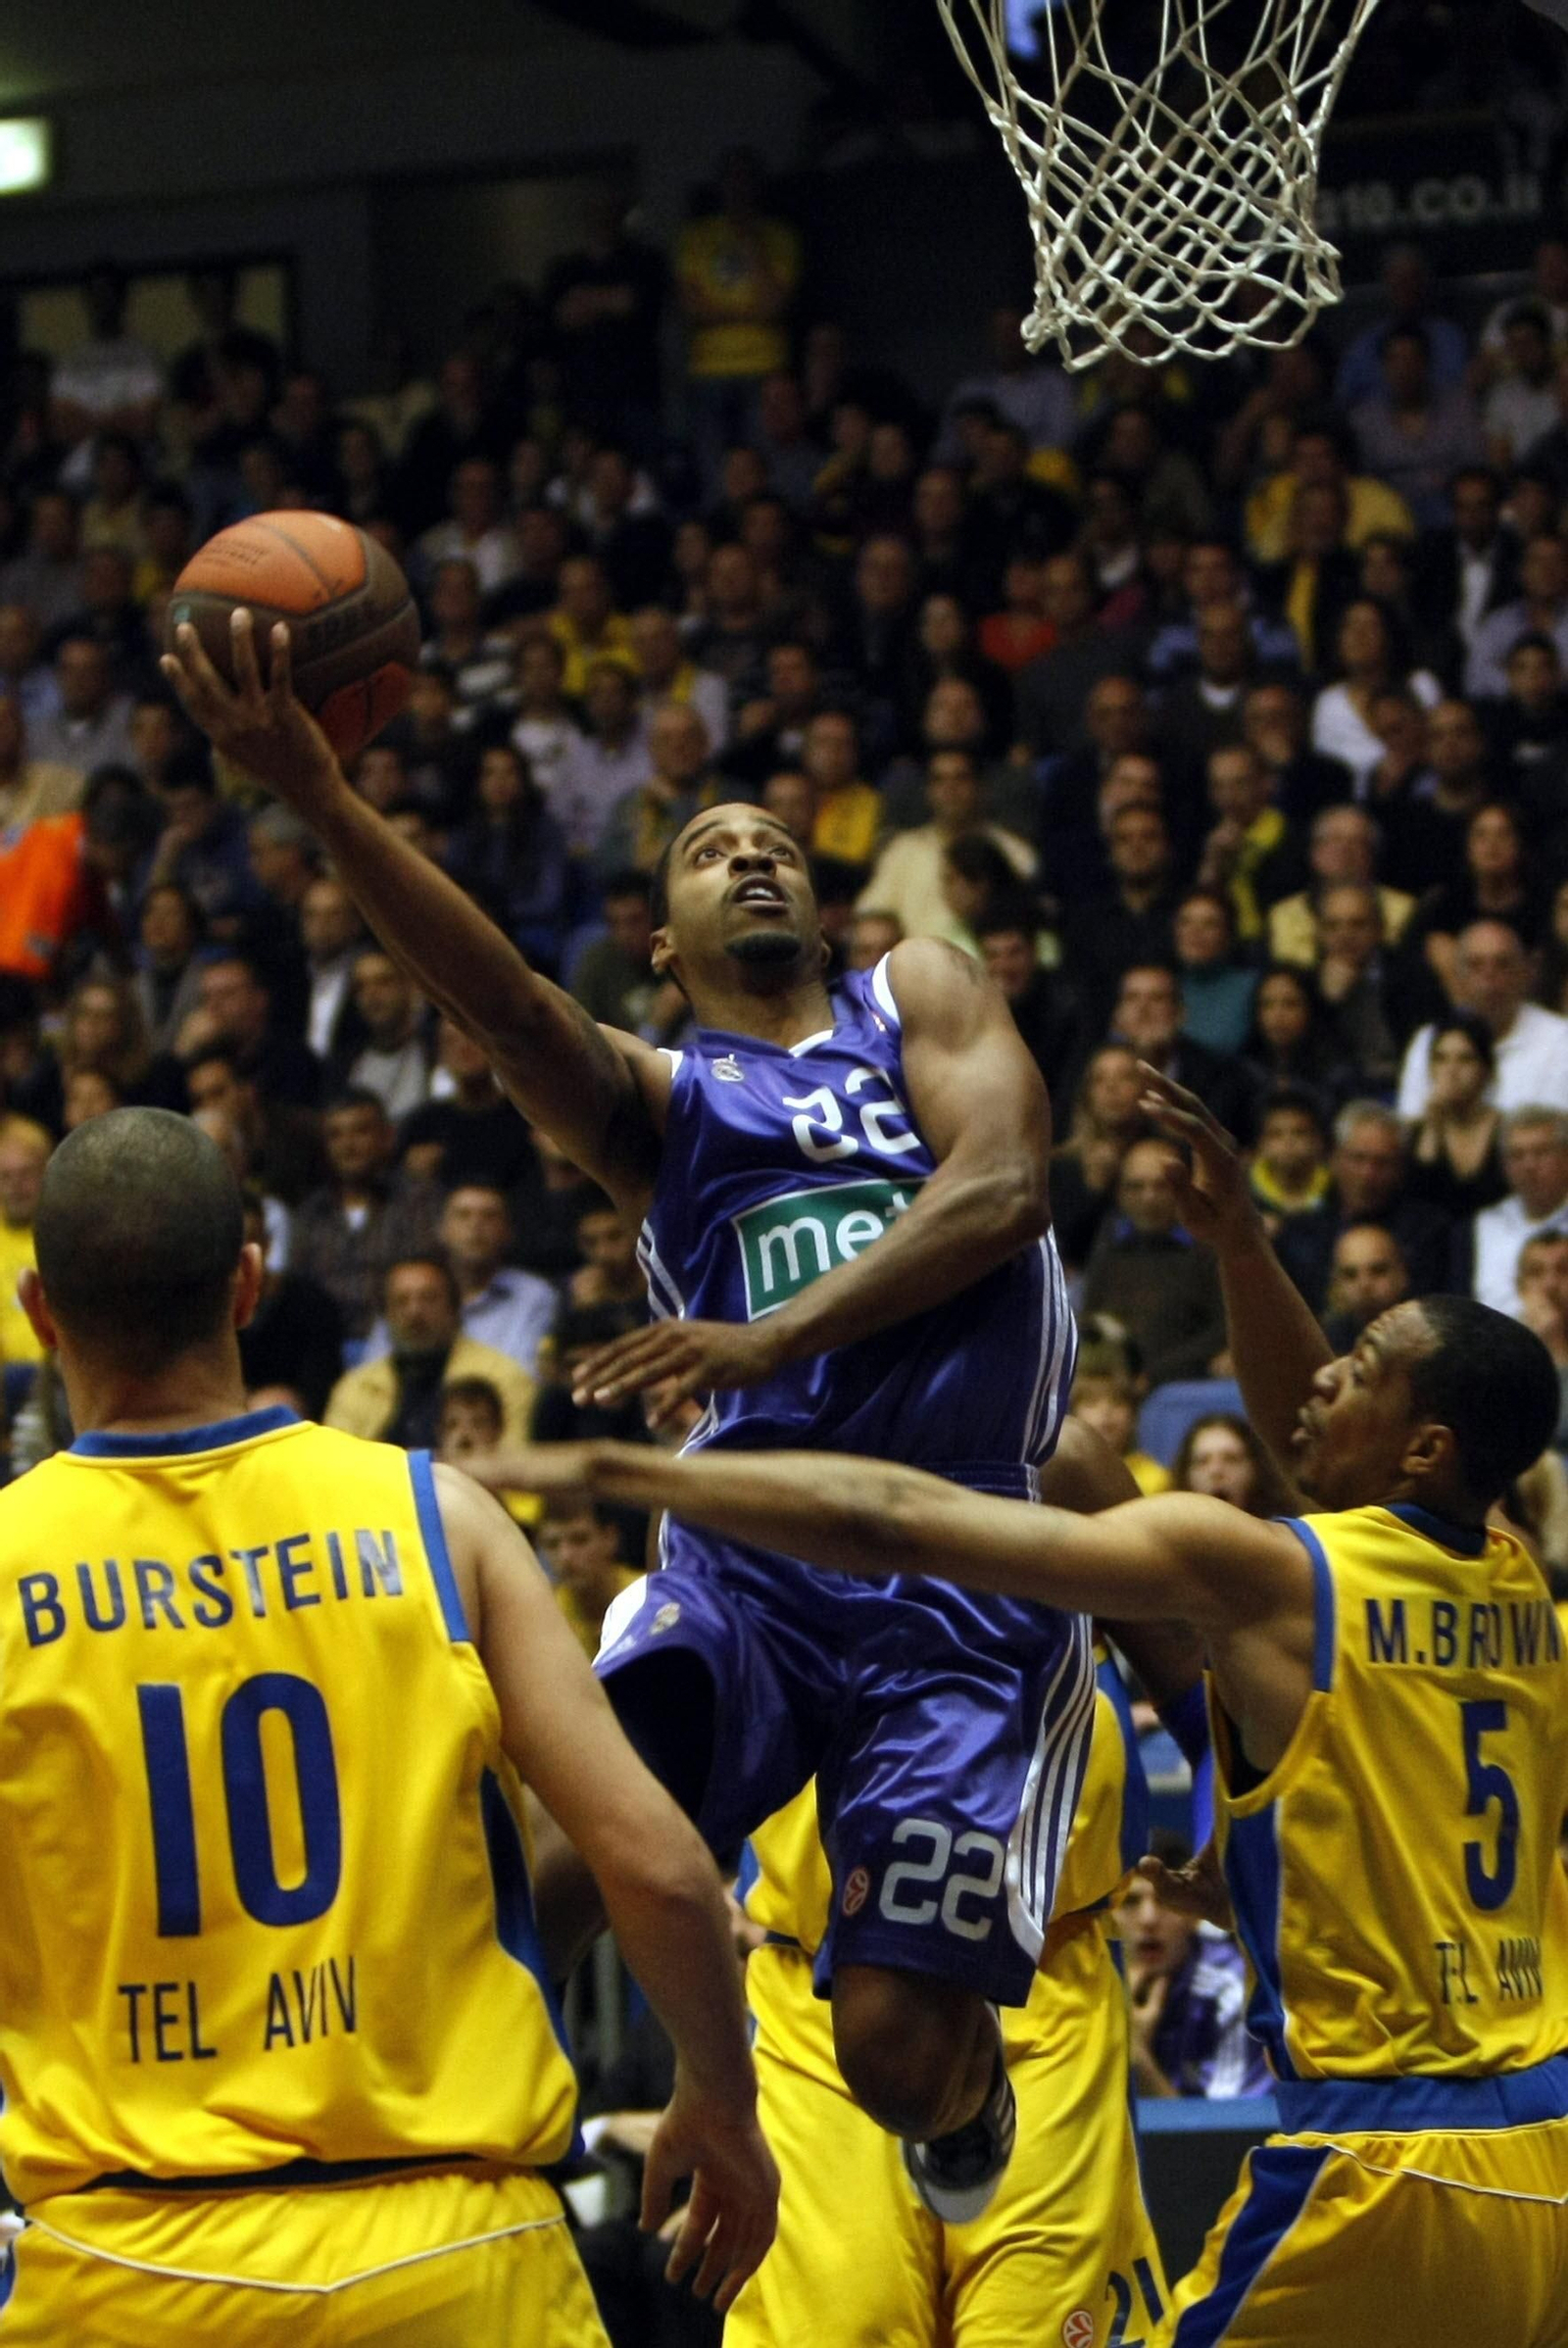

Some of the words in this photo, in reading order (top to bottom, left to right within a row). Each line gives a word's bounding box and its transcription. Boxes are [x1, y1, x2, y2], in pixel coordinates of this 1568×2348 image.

[783, 1067, 922, 1163] 22
[18, 1530, 403, 1647] BURSTEIN
[136, 1672, 343, 1937] 10
[1460, 1699, 1519, 1910] 5
[879, 1818, 1004, 1940] 22
[118, 1981, 218, 2064] TEL
[264, 1955, 358, 2052] AVIV
[1104, 2257, 1164, 2348] 21
